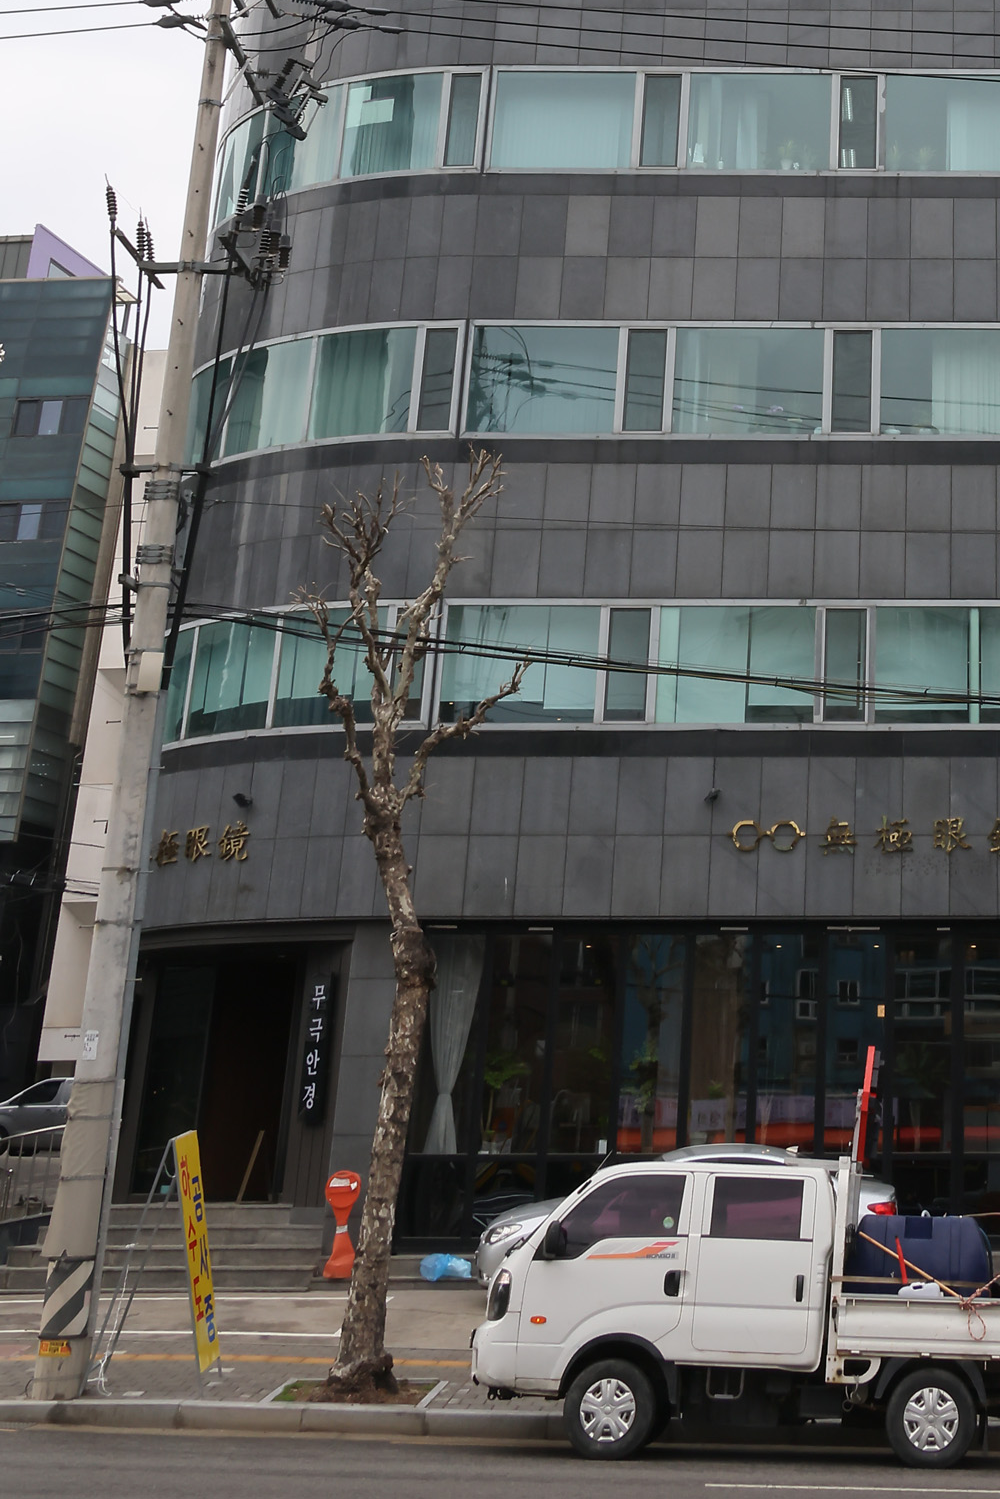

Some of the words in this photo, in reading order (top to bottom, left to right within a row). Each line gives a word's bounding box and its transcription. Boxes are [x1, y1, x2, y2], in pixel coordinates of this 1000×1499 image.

[152, 820, 251, 866] 極眼鏡
[302, 984, 326, 1110] 무극안경
